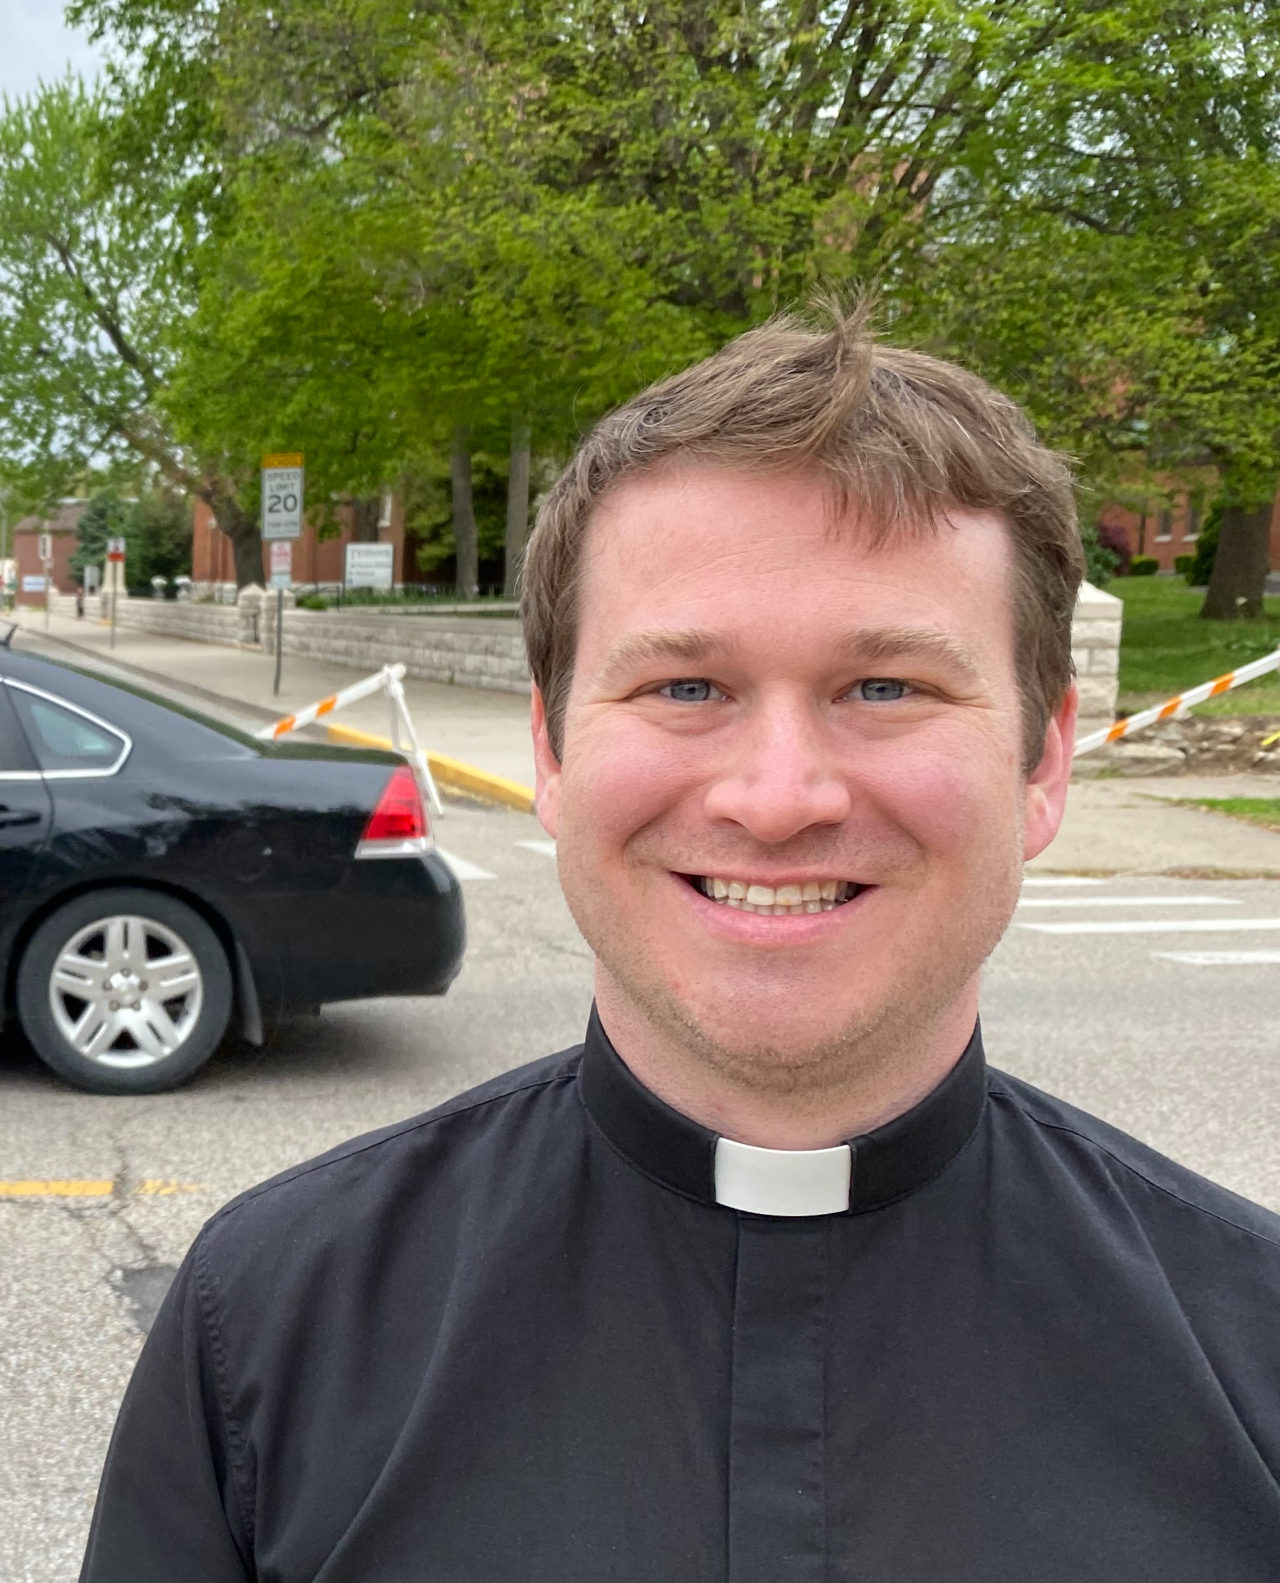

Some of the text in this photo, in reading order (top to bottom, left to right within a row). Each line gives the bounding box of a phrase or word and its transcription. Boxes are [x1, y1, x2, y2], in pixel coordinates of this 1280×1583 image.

[267, 471, 299, 480] SPEED
[270, 482, 295, 491] LIMIT
[268, 494, 298, 513] 20
